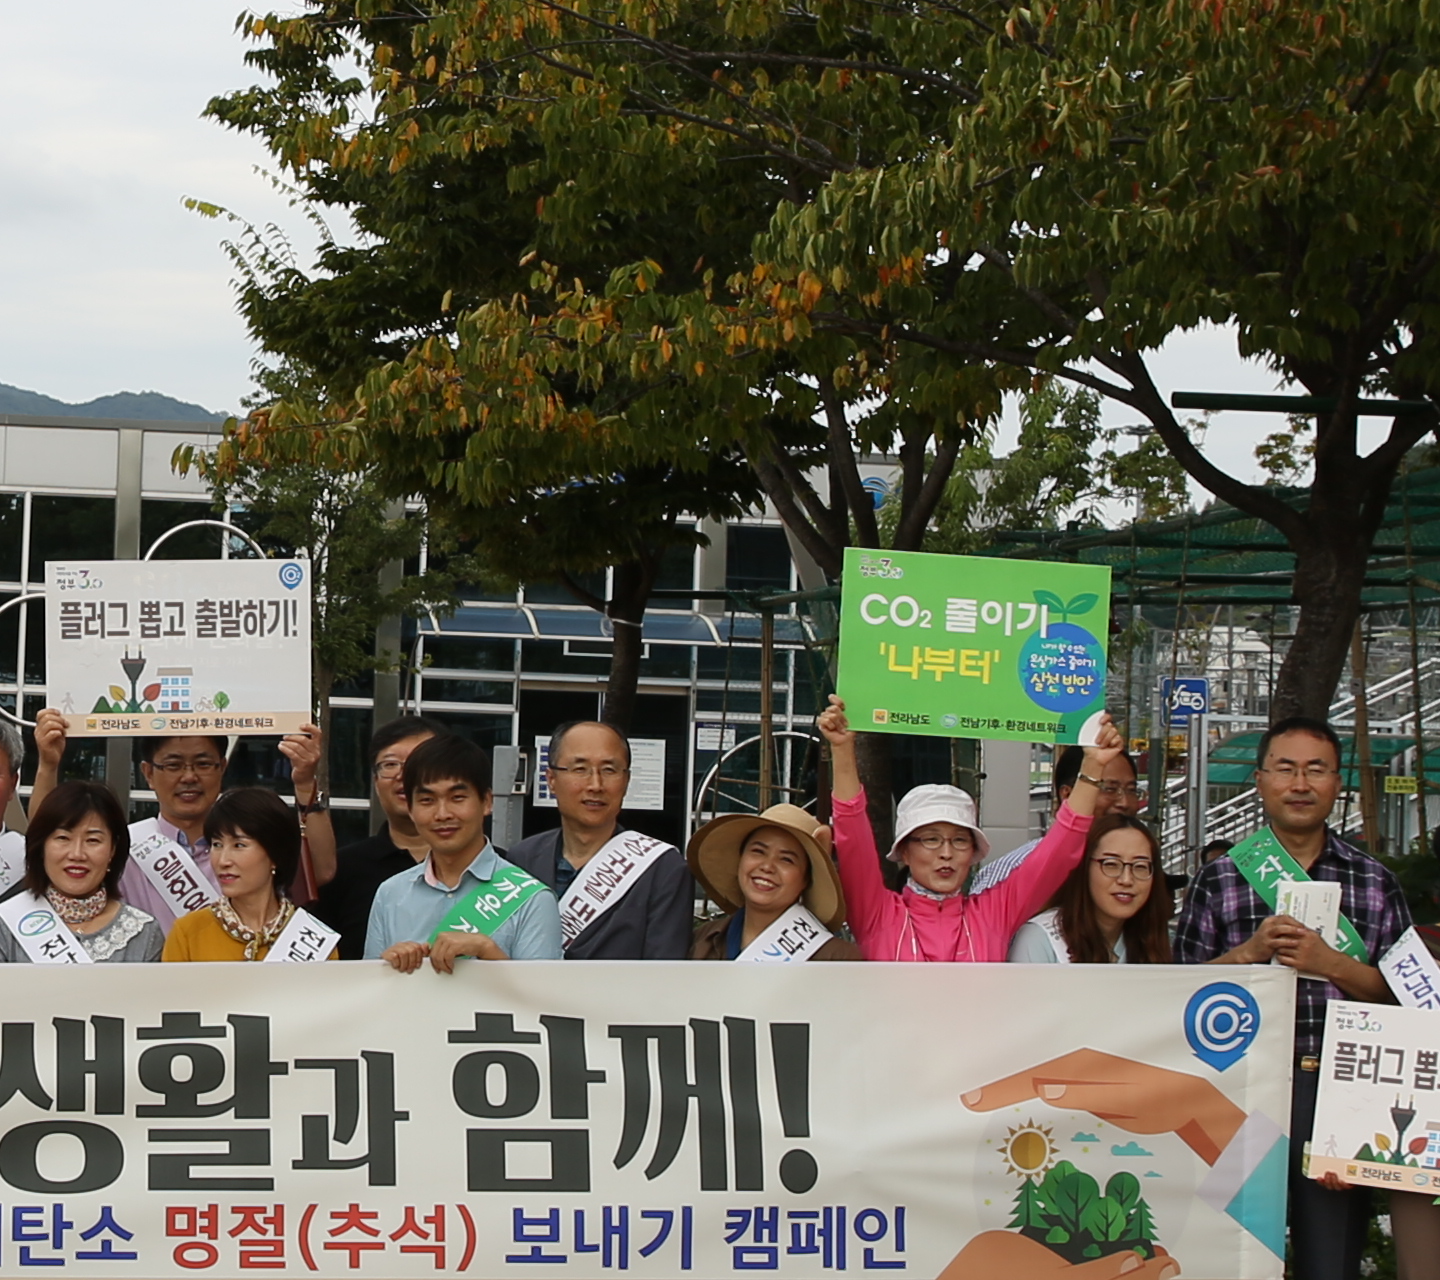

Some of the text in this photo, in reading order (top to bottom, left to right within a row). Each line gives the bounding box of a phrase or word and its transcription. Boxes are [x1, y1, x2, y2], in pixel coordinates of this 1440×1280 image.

[59, 598, 299, 640] 플러그 뽑고 출발하기!
[945, 597, 1049, 639] 줄이기
[879, 641, 1001, 685] '나부터'
[1029, 654, 1067, 669] 온실가스
[1029, 672, 1095, 696] 실천 방안
[100, 719, 142, 731] 전라남도
[888, 711, 931, 726] 전라남도
[1333, 1041, 1406, 1086] 플러그
[446, 1011, 819, 1197] 함께!
[1360, 1167, 1403, 1183] 전라남도
[164, 1201, 479, 1273] 명절(추석)
[505, 1204, 696, 1272] 보내기
[722, 1205, 909, 1274] 캠페인
